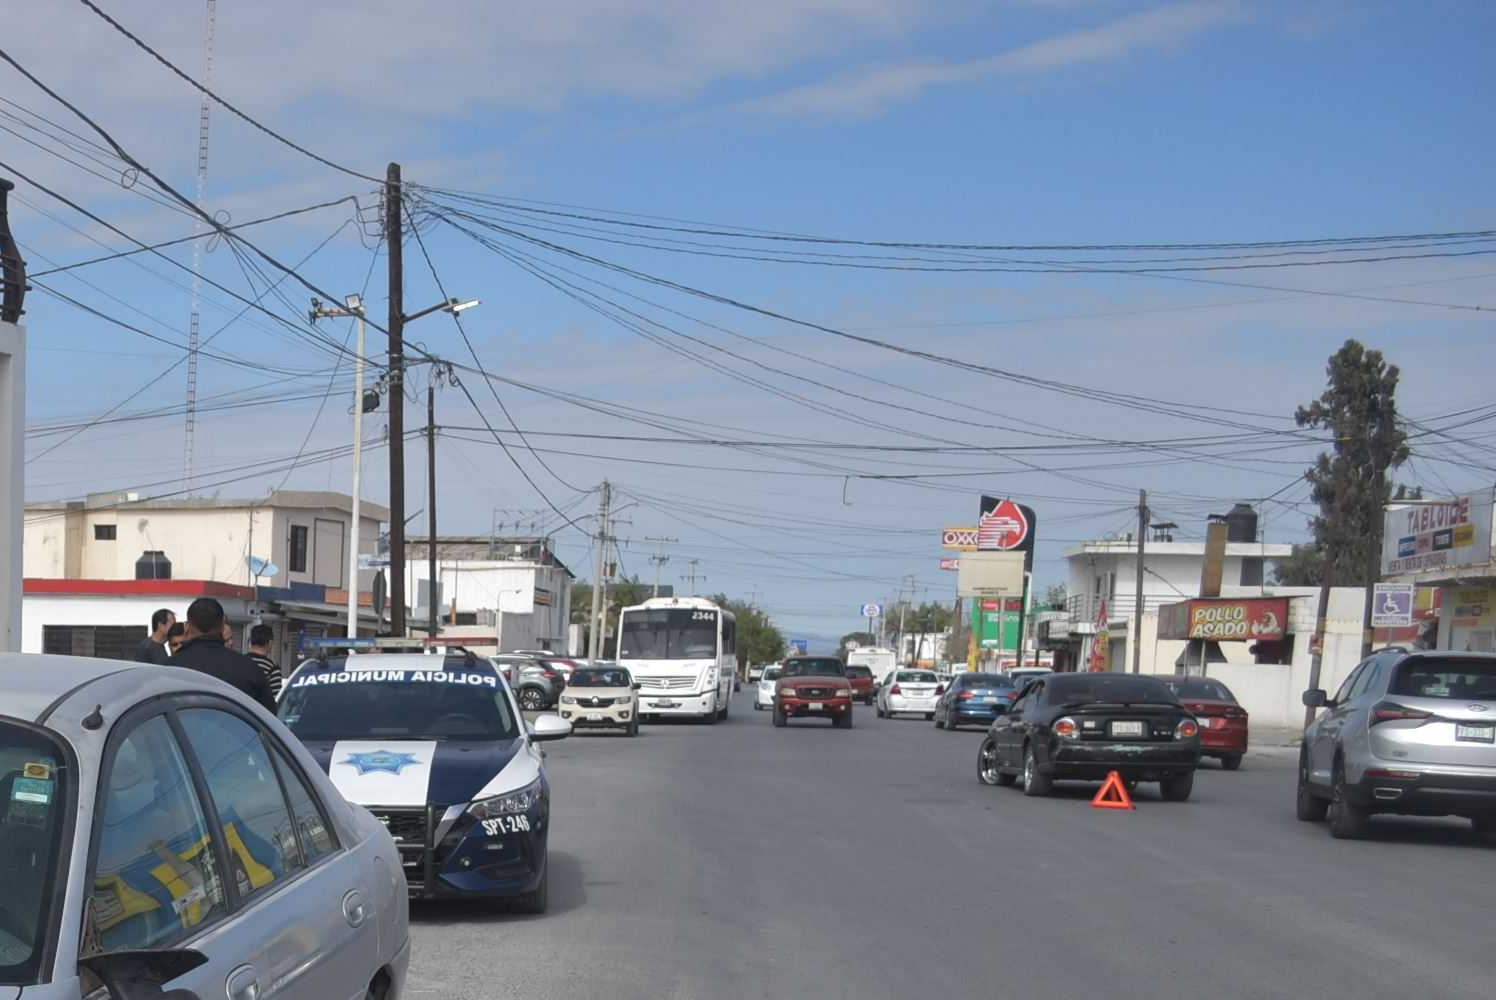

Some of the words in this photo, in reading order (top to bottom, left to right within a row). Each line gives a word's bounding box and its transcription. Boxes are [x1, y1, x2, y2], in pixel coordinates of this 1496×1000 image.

[944, 531, 979, 545] OXX
[1195, 606, 1245, 622] POLLO
[1192, 621, 1248, 638] ASADO
[481, 814, 531, 836] SPT-246
